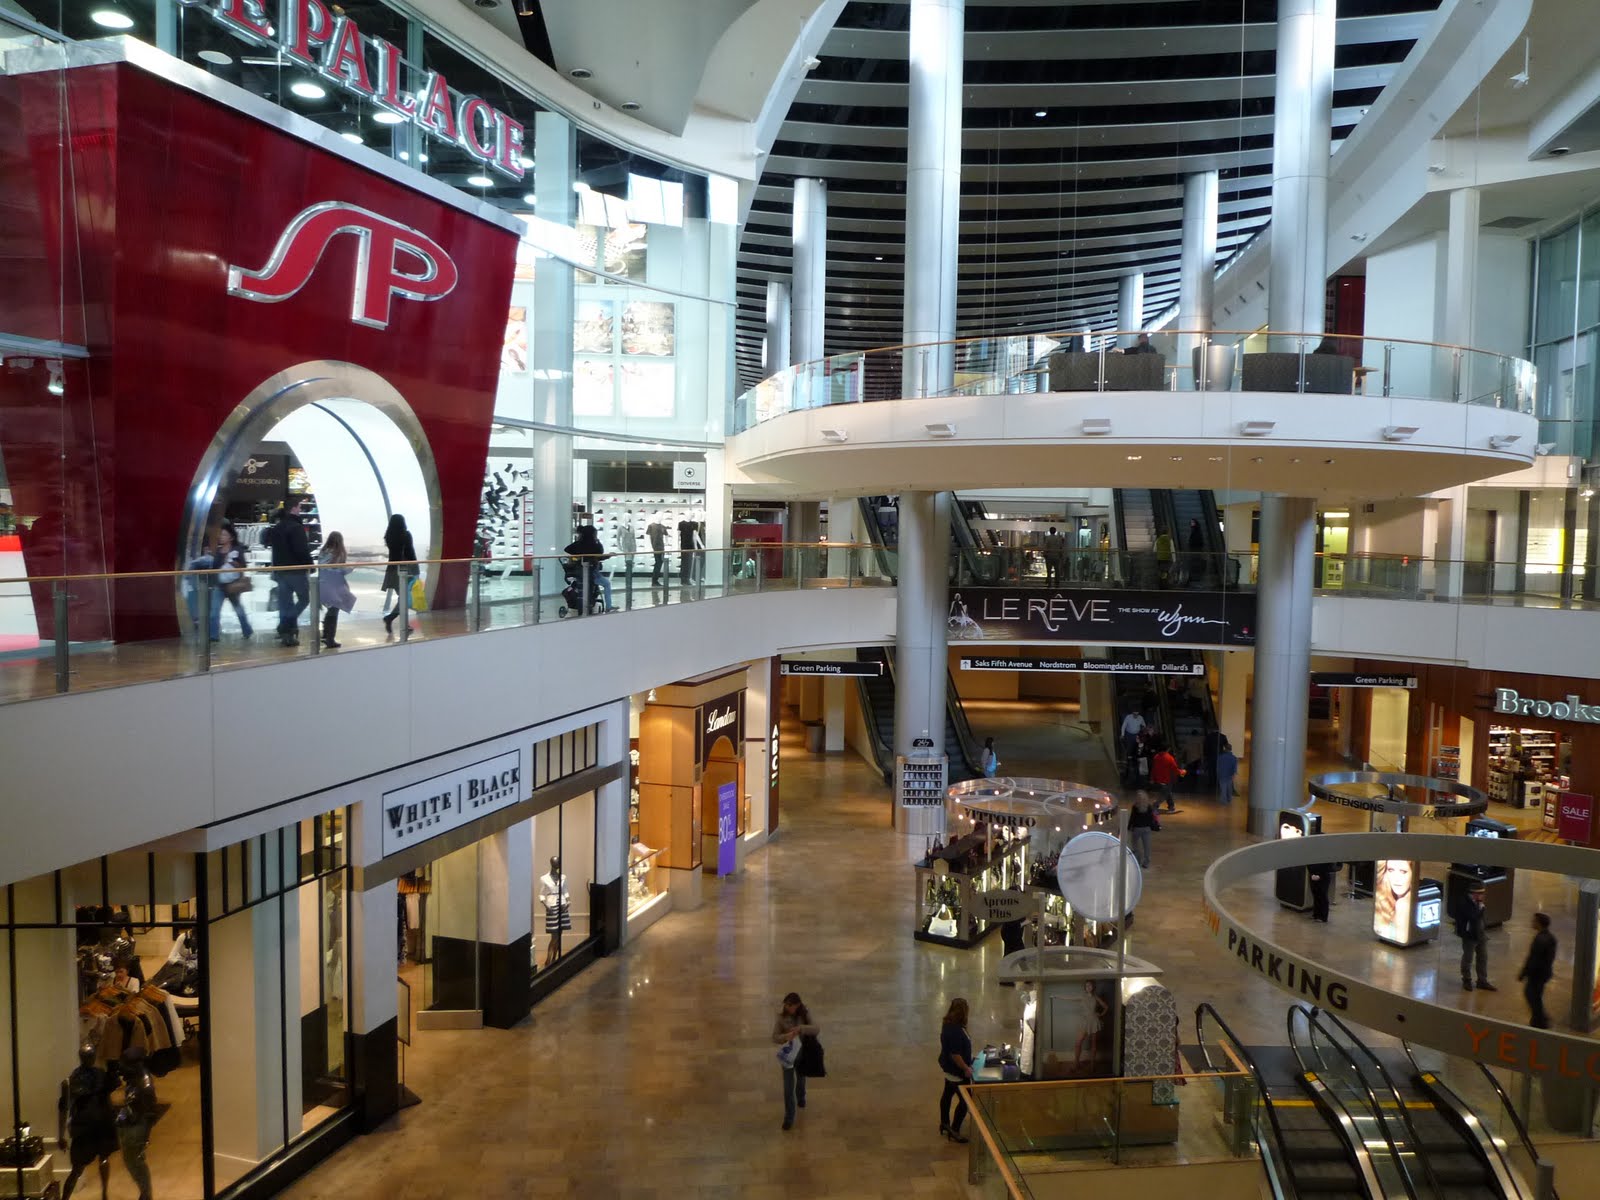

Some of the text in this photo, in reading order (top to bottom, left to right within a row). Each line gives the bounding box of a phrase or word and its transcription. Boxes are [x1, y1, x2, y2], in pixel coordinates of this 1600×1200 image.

[284, 0, 525, 181] PALACE
[983, 598, 1020, 620] LE
[1027, 593, 1111, 632] RÊVE
[793, 664, 842, 674] Green Parking
[1040, 661, 1077, 669] Nordstrom
[1083, 662, 1134, 671] Bloomingdale's
[1134, 663, 1155, 671] Home
[1355, 676, 1404, 686] Green Parking
[386, 767, 519, 829] WHITE BLACK
[473, 787, 514, 808] MARKET
[1327, 795, 1385, 813] EXTENSIONS
[964, 807, 1037, 828] VITTORIO
[1562, 805, 1590, 818] SALE
[397, 815, 441, 838] HOUSE
[983, 897, 1020, 908] Aprons
[988, 908, 1012, 918] Plus
[1227, 927, 1348, 1011] PARKING
